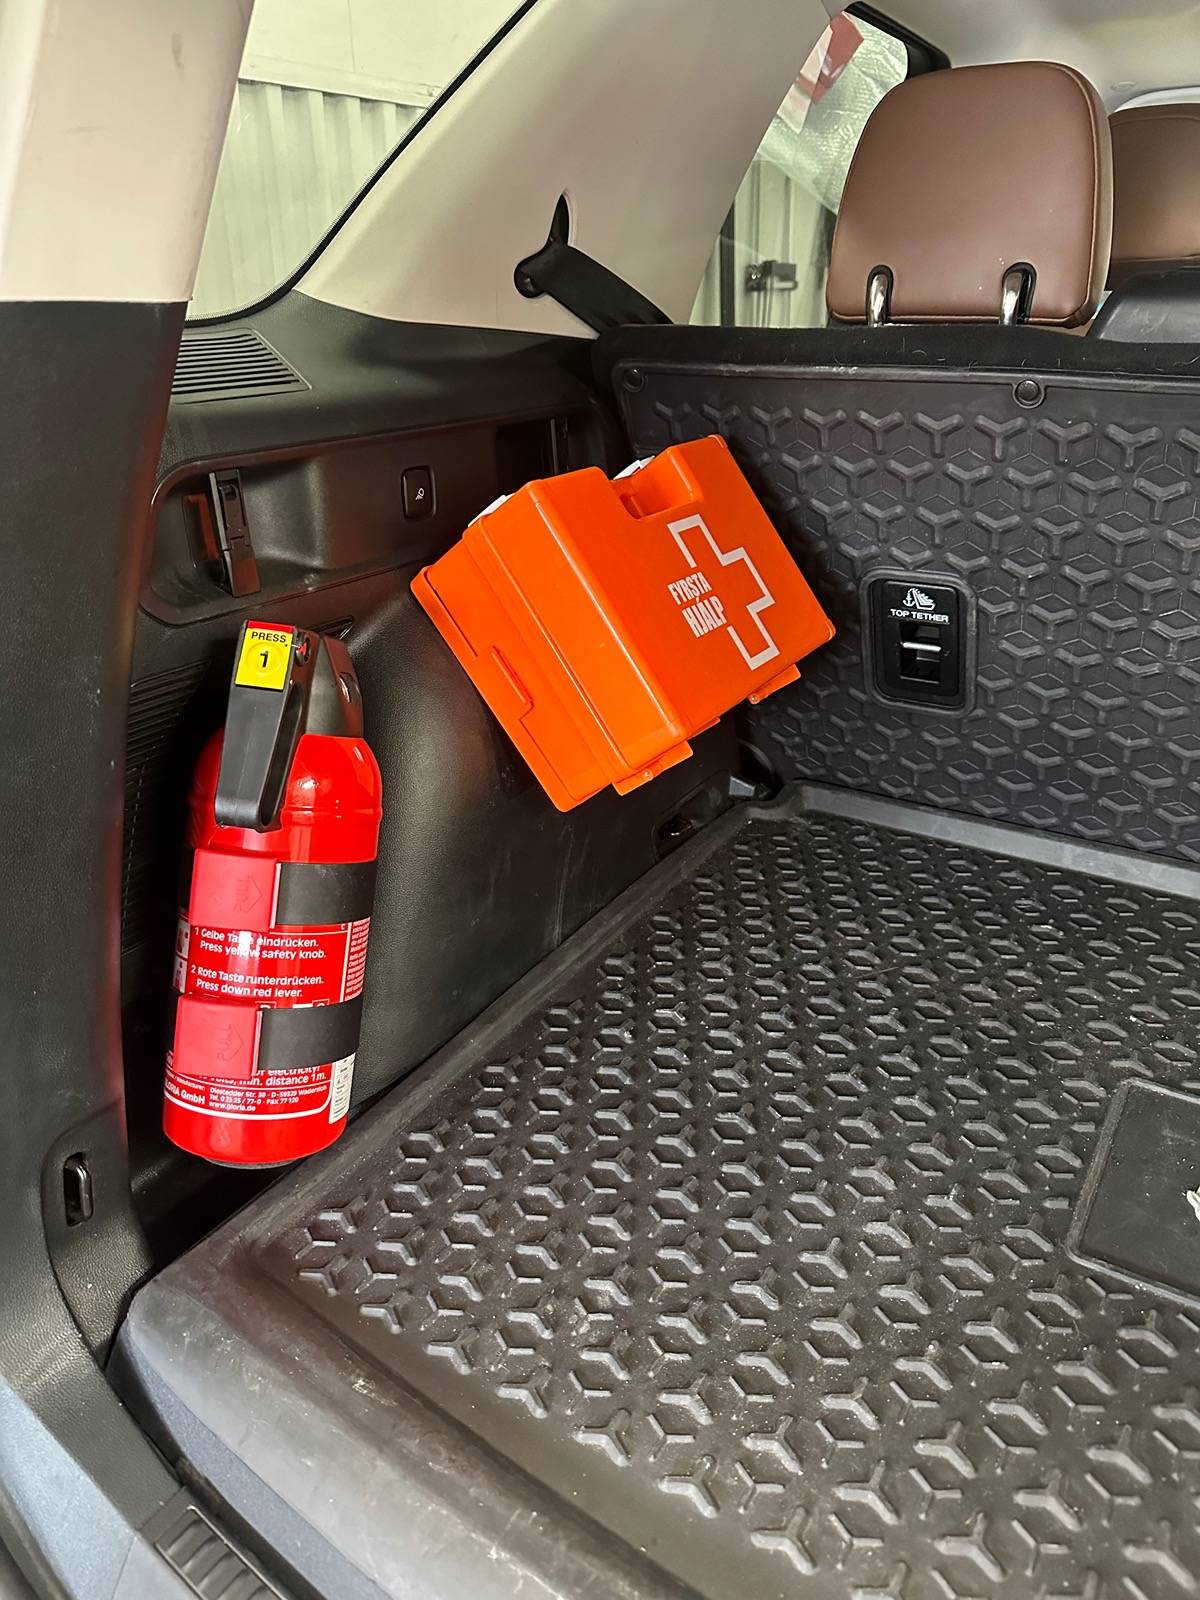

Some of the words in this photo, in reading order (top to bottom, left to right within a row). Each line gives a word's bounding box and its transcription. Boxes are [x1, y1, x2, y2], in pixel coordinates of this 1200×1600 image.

[667, 572, 712, 605] FYRSTA
[890, 608, 909, 617] TOP
[911, 611, 949, 623] TETHER
[251, 631, 287, 643] PRESS
[260, 650, 268, 668] 1
[201, 928, 225, 941] Gelbe
[227, 932, 254, 946] Tae
[200, 940, 223, 953] Press
[225, 946, 260, 957] yelw
[262, 949, 297, 961] safety
[299, 949, 327, 960] knob.
[191, 964, 196, 974] 2
[197, 966, 217, 979] Rote
[218, 971, 244, 983] Taste
[245, 975, 325, 986] runterdrücken.
[196, 979, 219, 992] Press
[221, 983, 251, 996] down
[253, 987, 272, 998] red
[274, 988, 303, 998] lever.
[265, 1074, 309, 1087] distance
[181, 1089, 206, 1105] GmbH
